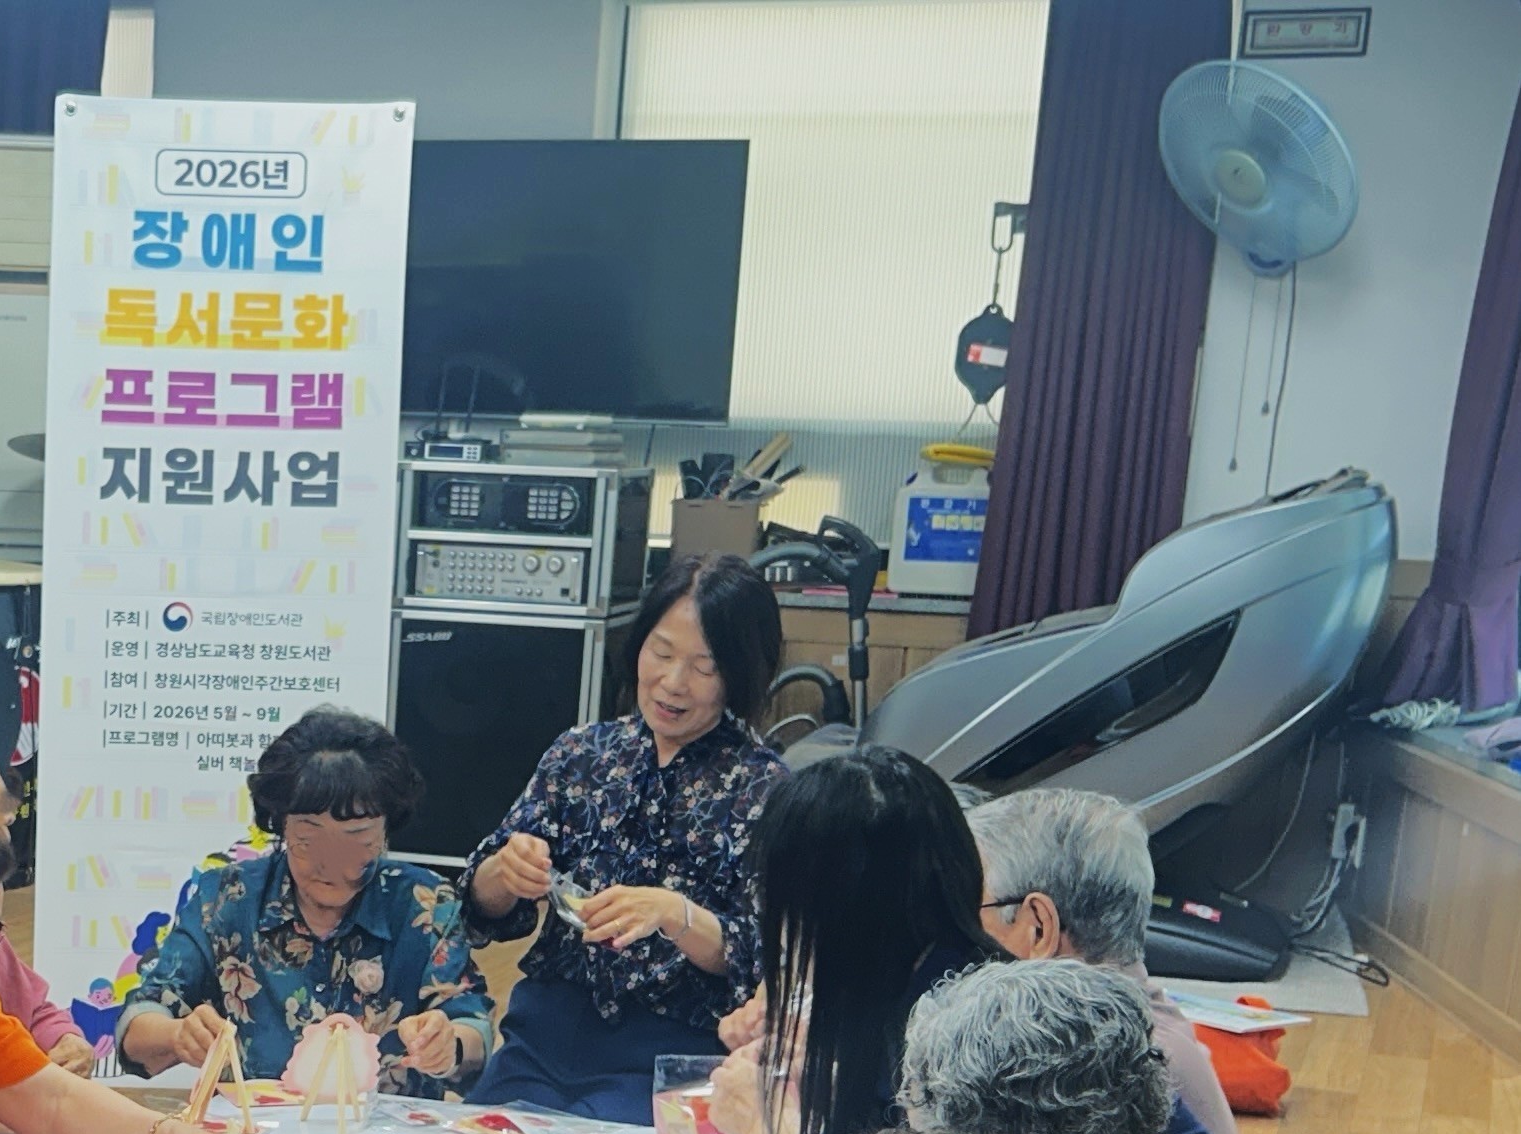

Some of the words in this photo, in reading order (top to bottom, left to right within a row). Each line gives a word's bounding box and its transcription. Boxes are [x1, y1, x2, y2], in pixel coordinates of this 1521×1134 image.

[174, 158, 289, 190] 2026년
[132, 209, 325, 273] 장애인
[104, 288, 348, 350] 독서문화
[100, 368, 344, 430] 프로그램
[99, 447, 340, 508] 지원사업
[112, 610, 141, 626] 주최
[201, 610, 303, 627] 국립장애인도서관
[111, 640, 139, 657] 운영
[155, 641, 256, 660] 경상남도교육청
[259, 643, 331, 662] 창원도서관
[110, 672, 138, 689] 참여
[154, 672, 340, 692] 창원시각장애인주간보호센터
[109, 703, 138, 719] 기간
[153, 704, 209, 721] 2026년
[214, 705, 238, 722] 5월
[257, 705, 281, 723] 9월
[108, 730, 179, 747] 프로그램명
[197, 754, 225, 772] 실버
